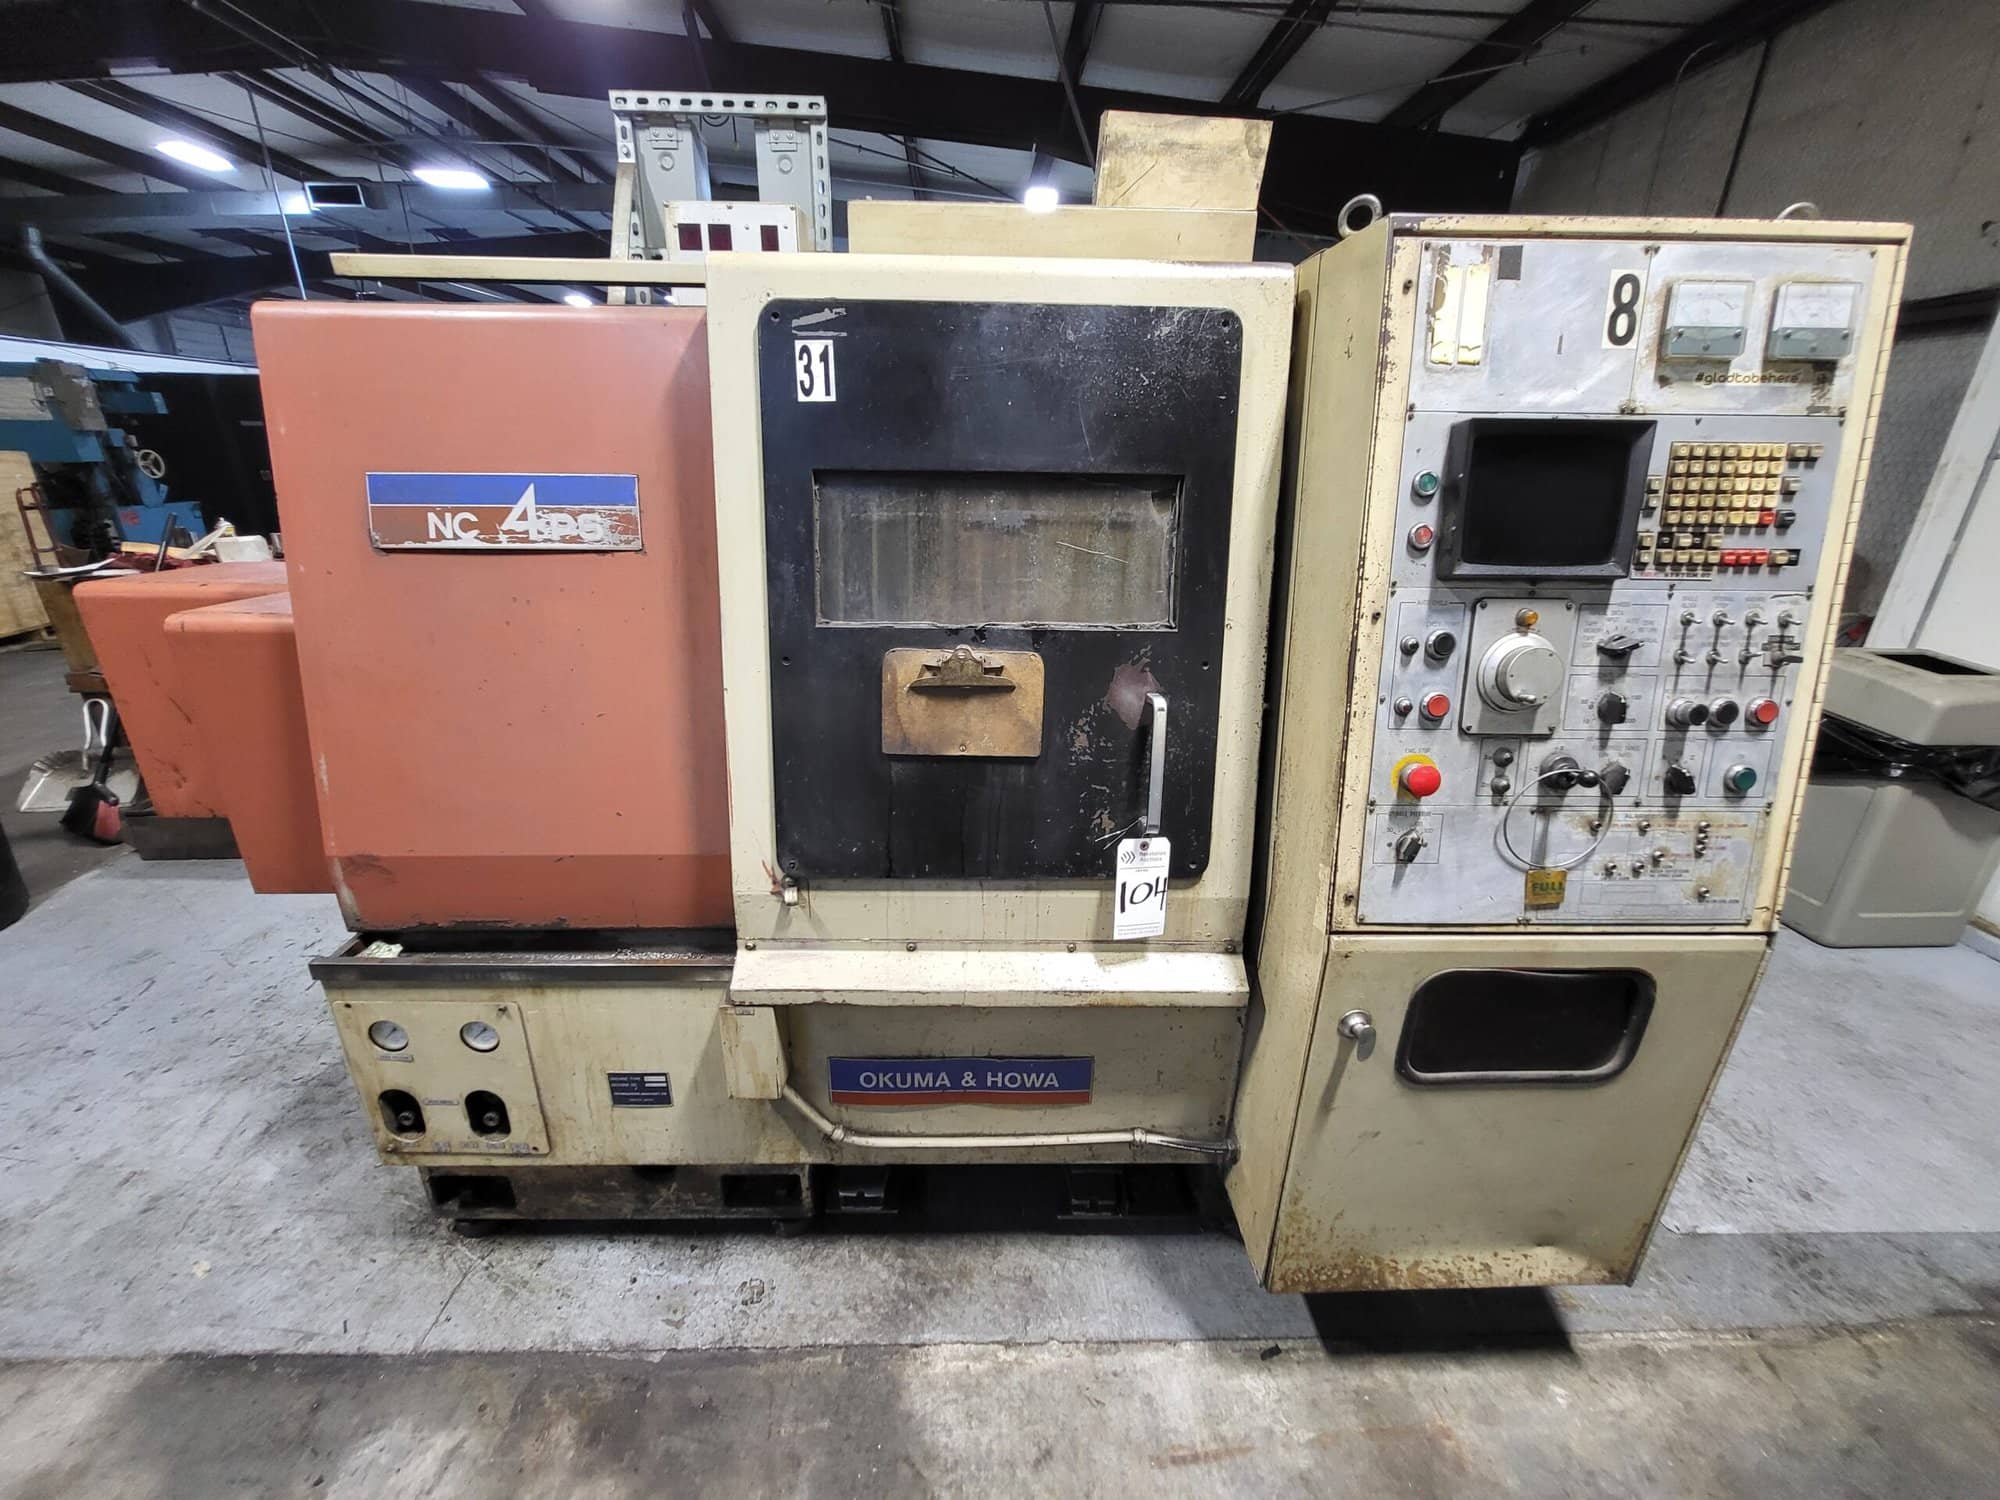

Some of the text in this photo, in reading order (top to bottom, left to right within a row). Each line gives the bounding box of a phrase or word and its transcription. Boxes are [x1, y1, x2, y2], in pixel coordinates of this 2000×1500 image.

[1606, 272, 1642, 347] 8
[798, 344, 832, 398] 31
[427, 511, 480, 540] NC
[1119, 875, 1169, 914] 104
[859, 1071, 1060, 1089] OKUMA & HOWA
